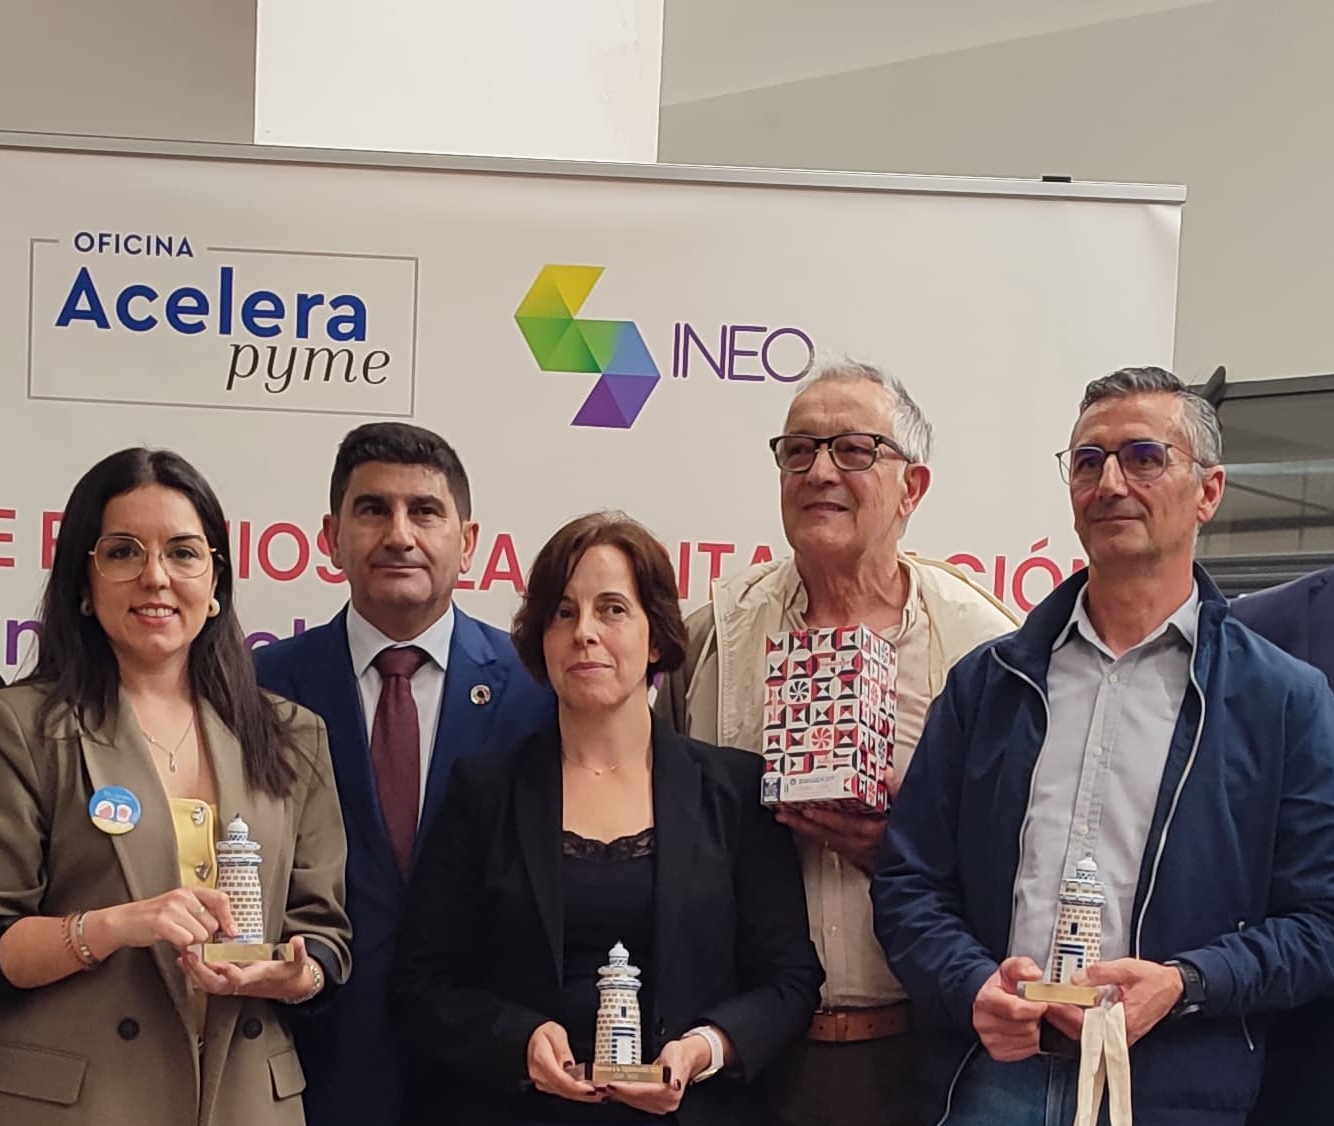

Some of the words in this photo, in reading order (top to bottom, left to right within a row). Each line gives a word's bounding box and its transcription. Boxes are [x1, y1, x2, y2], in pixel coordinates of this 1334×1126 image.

[74, 231, 195, 258] OFICINA
[54, 266, 368, 343] Acelera
[225, 341, 392, 394] pyme
[672, 322, 816, 383] INEO
